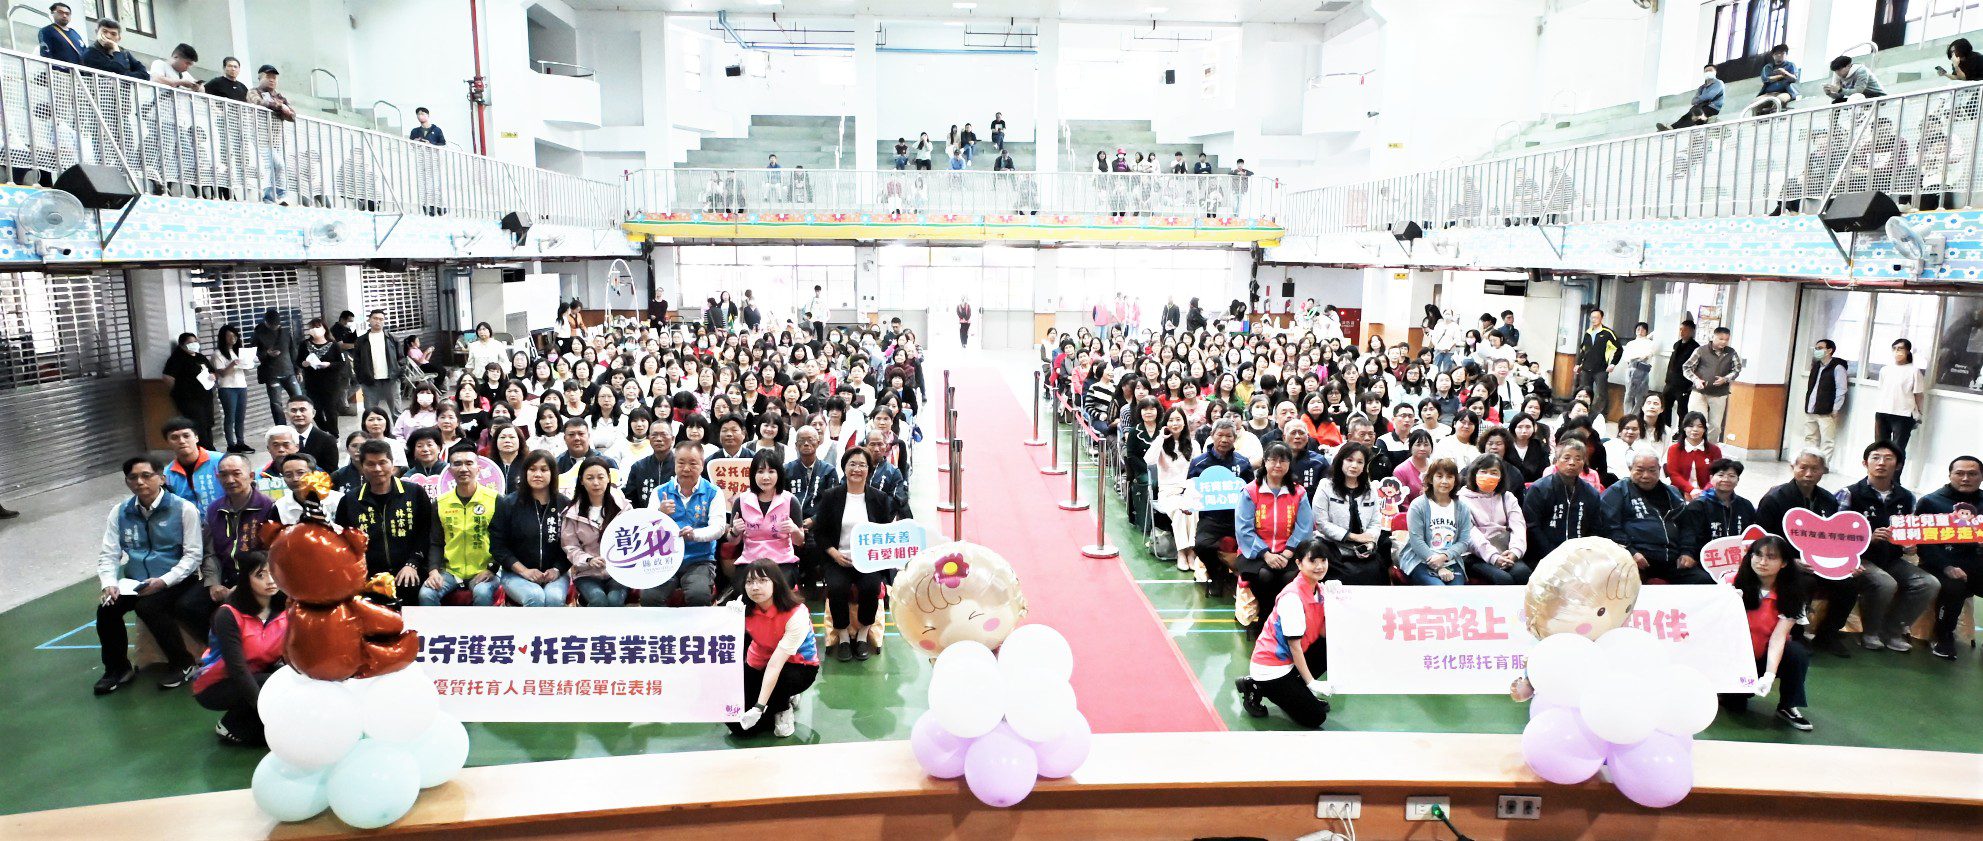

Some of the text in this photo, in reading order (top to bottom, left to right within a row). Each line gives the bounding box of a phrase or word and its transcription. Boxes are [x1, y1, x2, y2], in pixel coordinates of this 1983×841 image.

[614, 525, 673, 558] 彰化
[858, 530, 910, 546] 托育友善
[867, 546, 919, 561] 有愛相伴
[1704, 545, 1748, 565] 平價
[1382, 605, 1509, 641] 托育路上
[530, 634, 736, 664] 托育專業護兒權
[433, 679, 663, 696] 優質托育人員暨績優單位表揚
